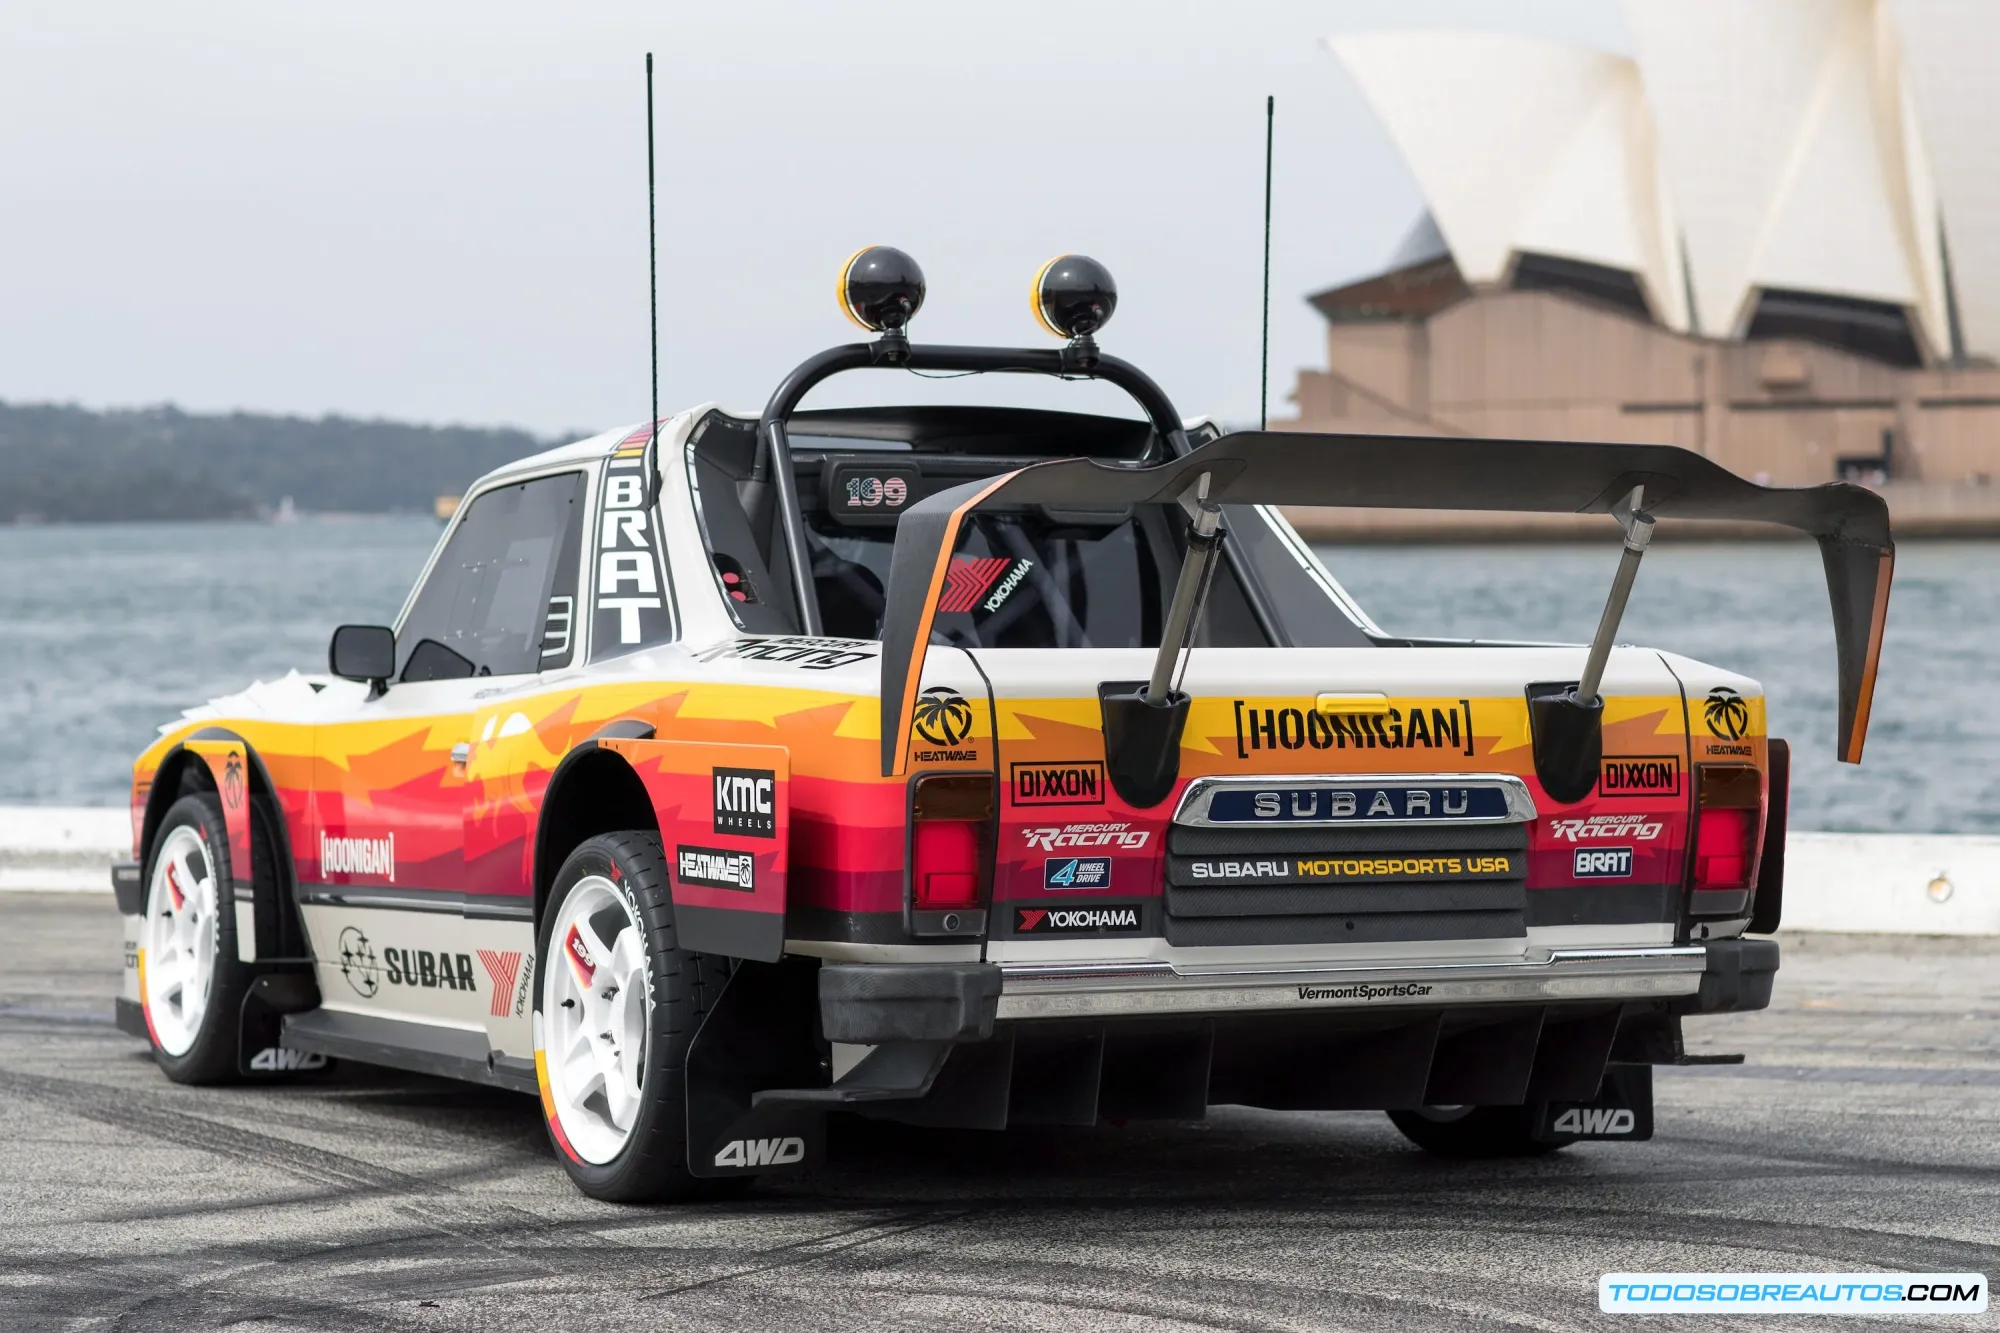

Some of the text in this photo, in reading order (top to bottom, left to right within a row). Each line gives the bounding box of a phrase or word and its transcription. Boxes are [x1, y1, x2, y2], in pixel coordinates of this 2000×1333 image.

[846, 477, 907, 506] 199
[598, 475, 661, 643] BRAT
[984, 558, 1034, 613] YOKOHAMA
[914, 751, 977, 762] HEATWAVE
[1706, 745, 1752, 756] HEATWAVE
[1019, 769, 1097, 797] DIXXON
[1605, 763, 1673, 789] DIXXON
[1254, 790, 1469, 817] SUBARU
[717, 816, 772, 829] WHEELS
[1063, 823, 1132, 833] MERCURY
[1551, 820, 1663, 842] Racing
[1586, 815, 1648, 824] MERCURY
[1022, 828, 1150, 851] Racing
[679, 851, 739, 882] HEATWAVE
[1050, 858, 1105, 886] 4 WHEEL
[1192, 857, 1510, 878] SUBARU MOTORSPORTS USA
[1576, 852, 1631, 872] BRAT
[1076, 874, 1101, 883] DRIVE
[1047, 909, 1138, 928] YOKOHAMA
[571, 937, 596, 968] 199
[1298, 983, 1432, 1000] VermontSportsCar
[251, 1048, 327, 1071] 4WD
[1554, 1108, 1635, 1134] 4WD
[715, 1137, 805, 1167] 4WD
